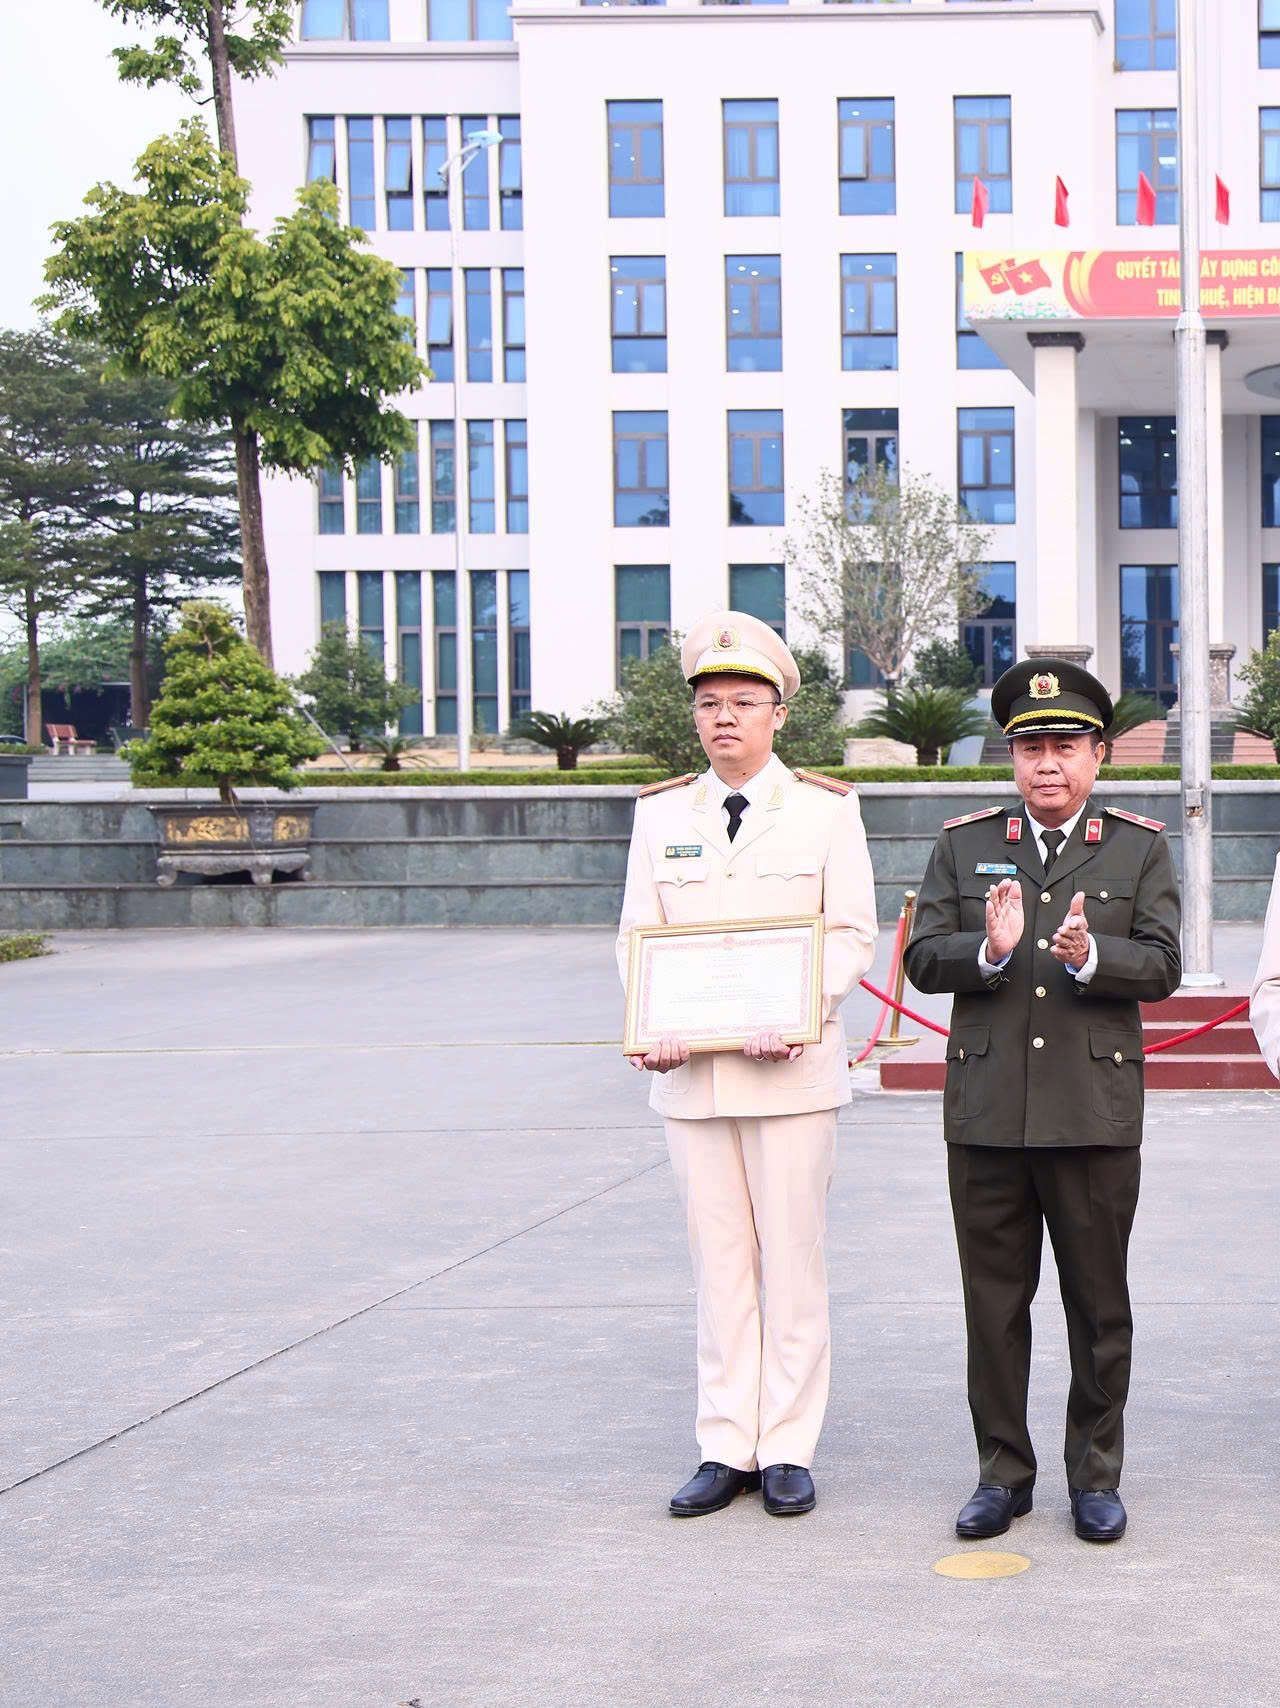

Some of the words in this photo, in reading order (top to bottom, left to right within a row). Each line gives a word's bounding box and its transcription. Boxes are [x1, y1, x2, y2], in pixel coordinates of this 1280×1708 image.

[1116, 256, 1157, 280] QUYẾT
[1160, 256, 1181, 278] TÂ
[1200, 256, 1218, 278] ÂY
[1222, 258, 1257, 280] DỰNG
[1157, 288, 1181, 306] TIN
[1200, 284, 1230, 309] HUỆ,
[1233, 284, 1264, 309] HIỆN
